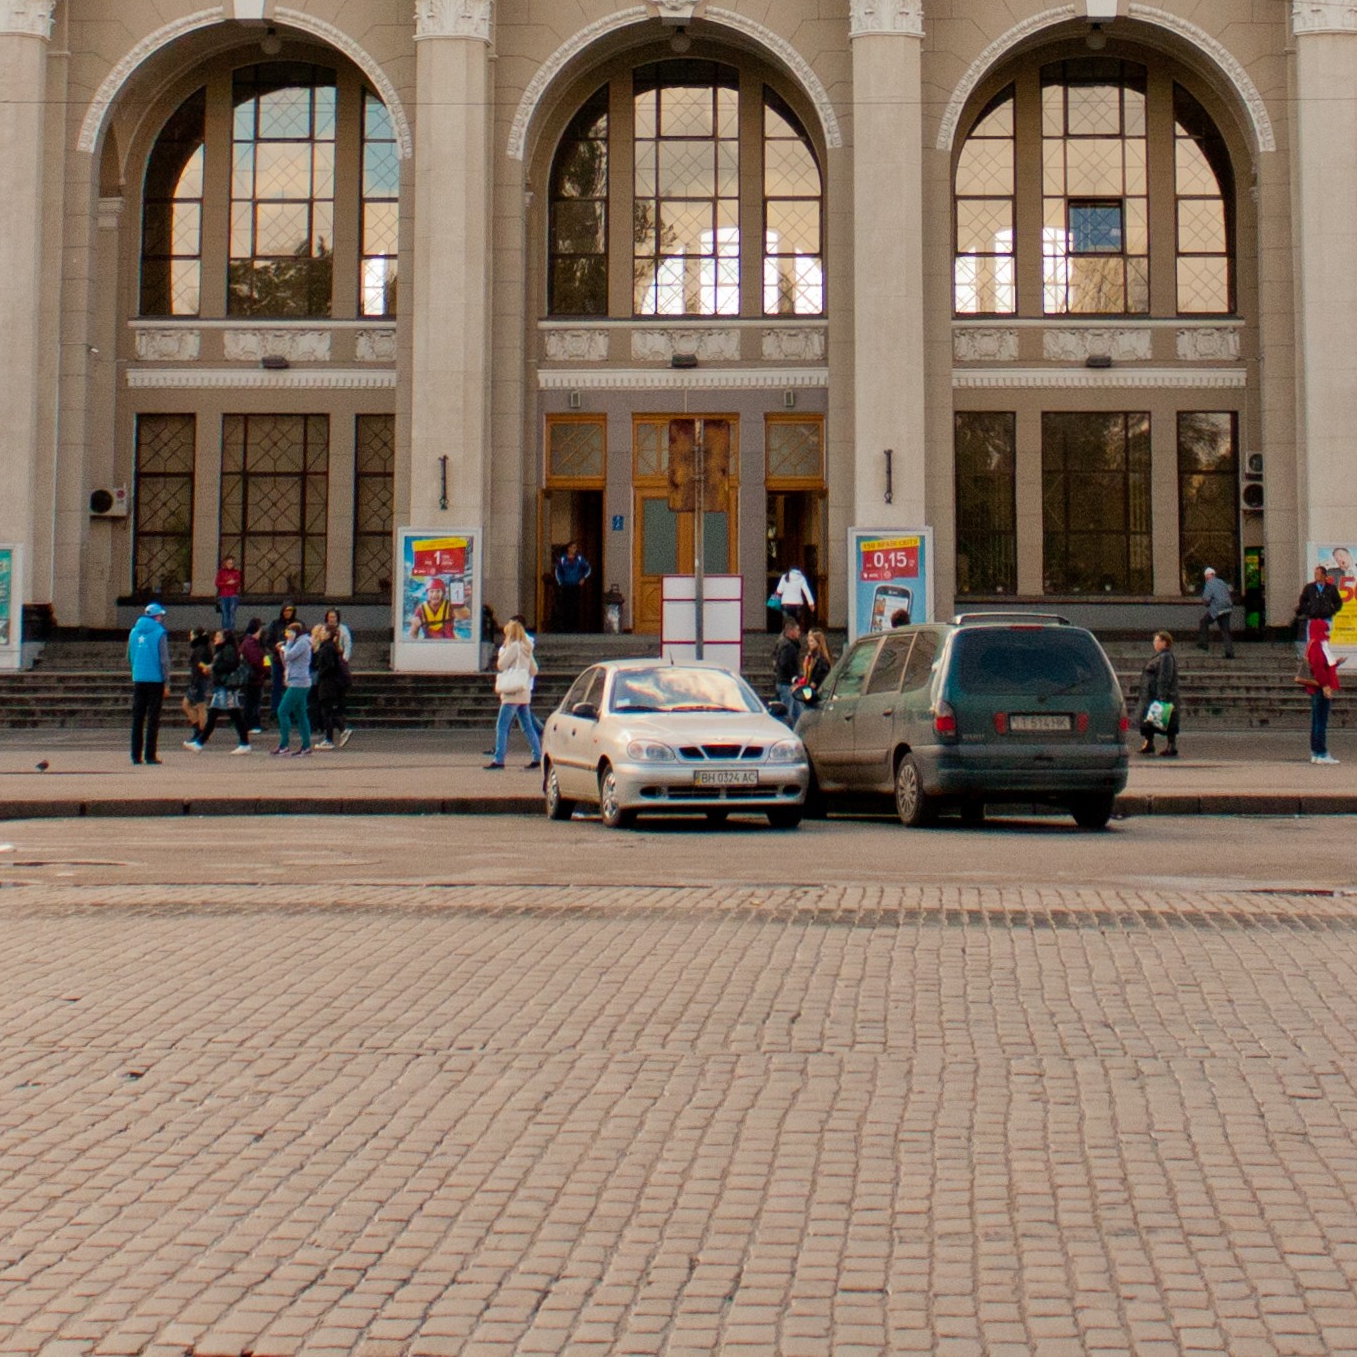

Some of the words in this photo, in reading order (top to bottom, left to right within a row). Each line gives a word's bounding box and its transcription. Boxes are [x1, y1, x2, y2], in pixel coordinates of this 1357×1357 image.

[434, 551, 441, 565] 1
[873, 551, 907, 570] 0,15
[702, 773, 715, 783] BH
[743, 772, 756, 782] AC
